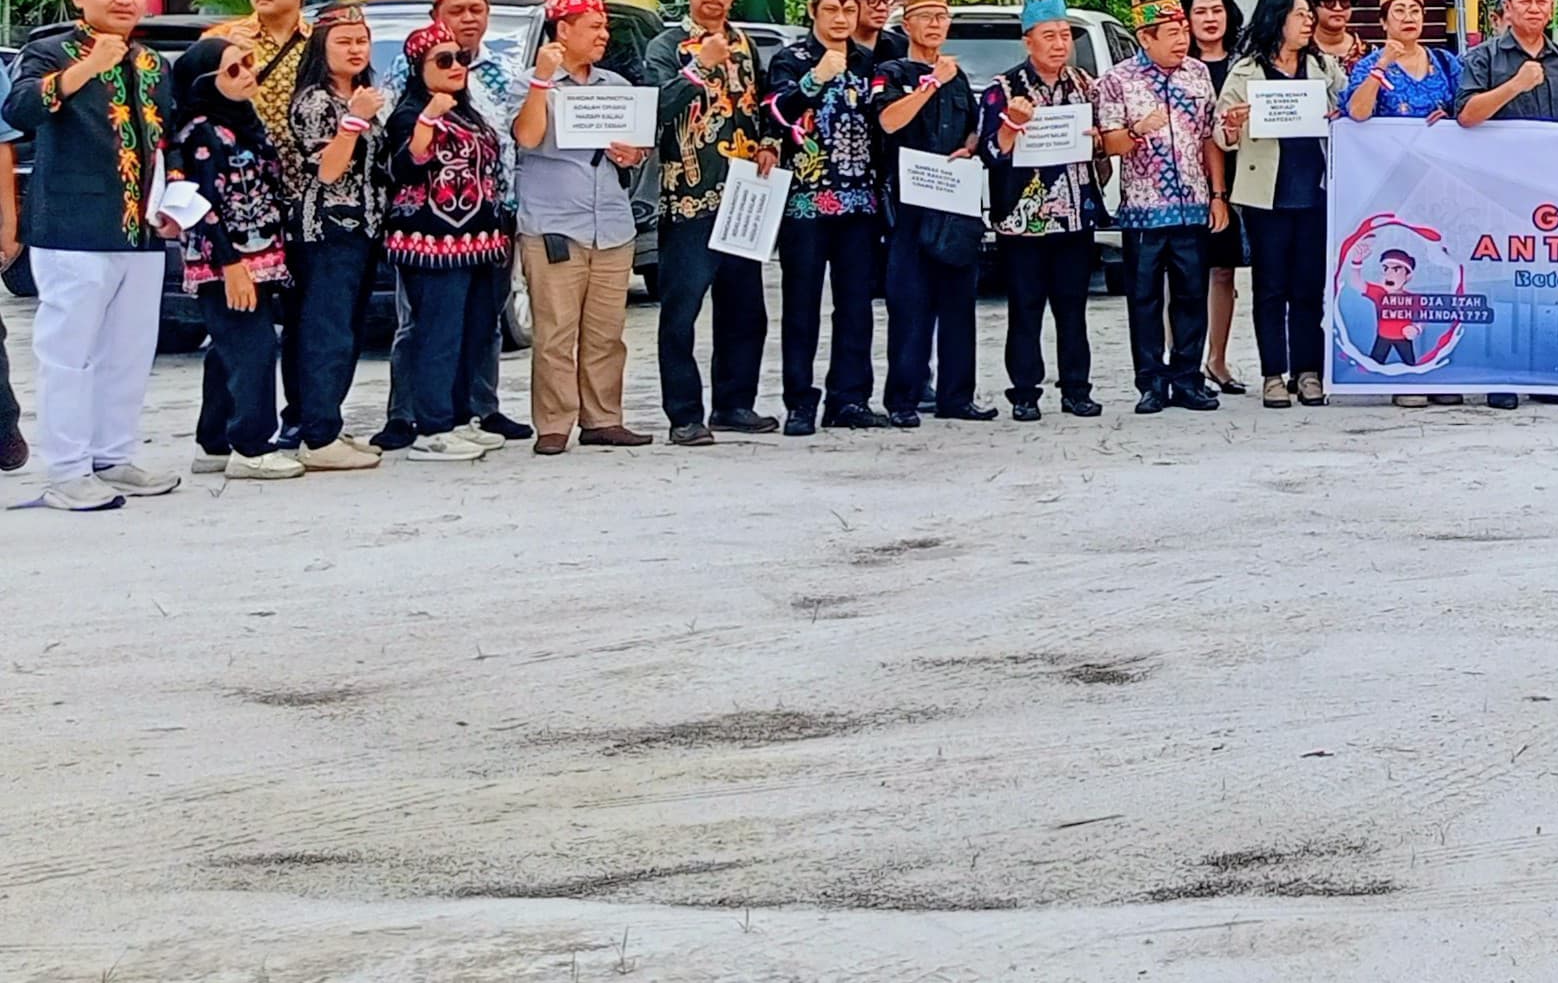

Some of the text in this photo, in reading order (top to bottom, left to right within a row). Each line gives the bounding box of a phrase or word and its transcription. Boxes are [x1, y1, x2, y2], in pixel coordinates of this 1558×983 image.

[1420, 296, 1444, 306] DIA
[1451, 296, 1481, 306] ITAH
[1382, 309, 1488, 320] EWEH HINDAI???
